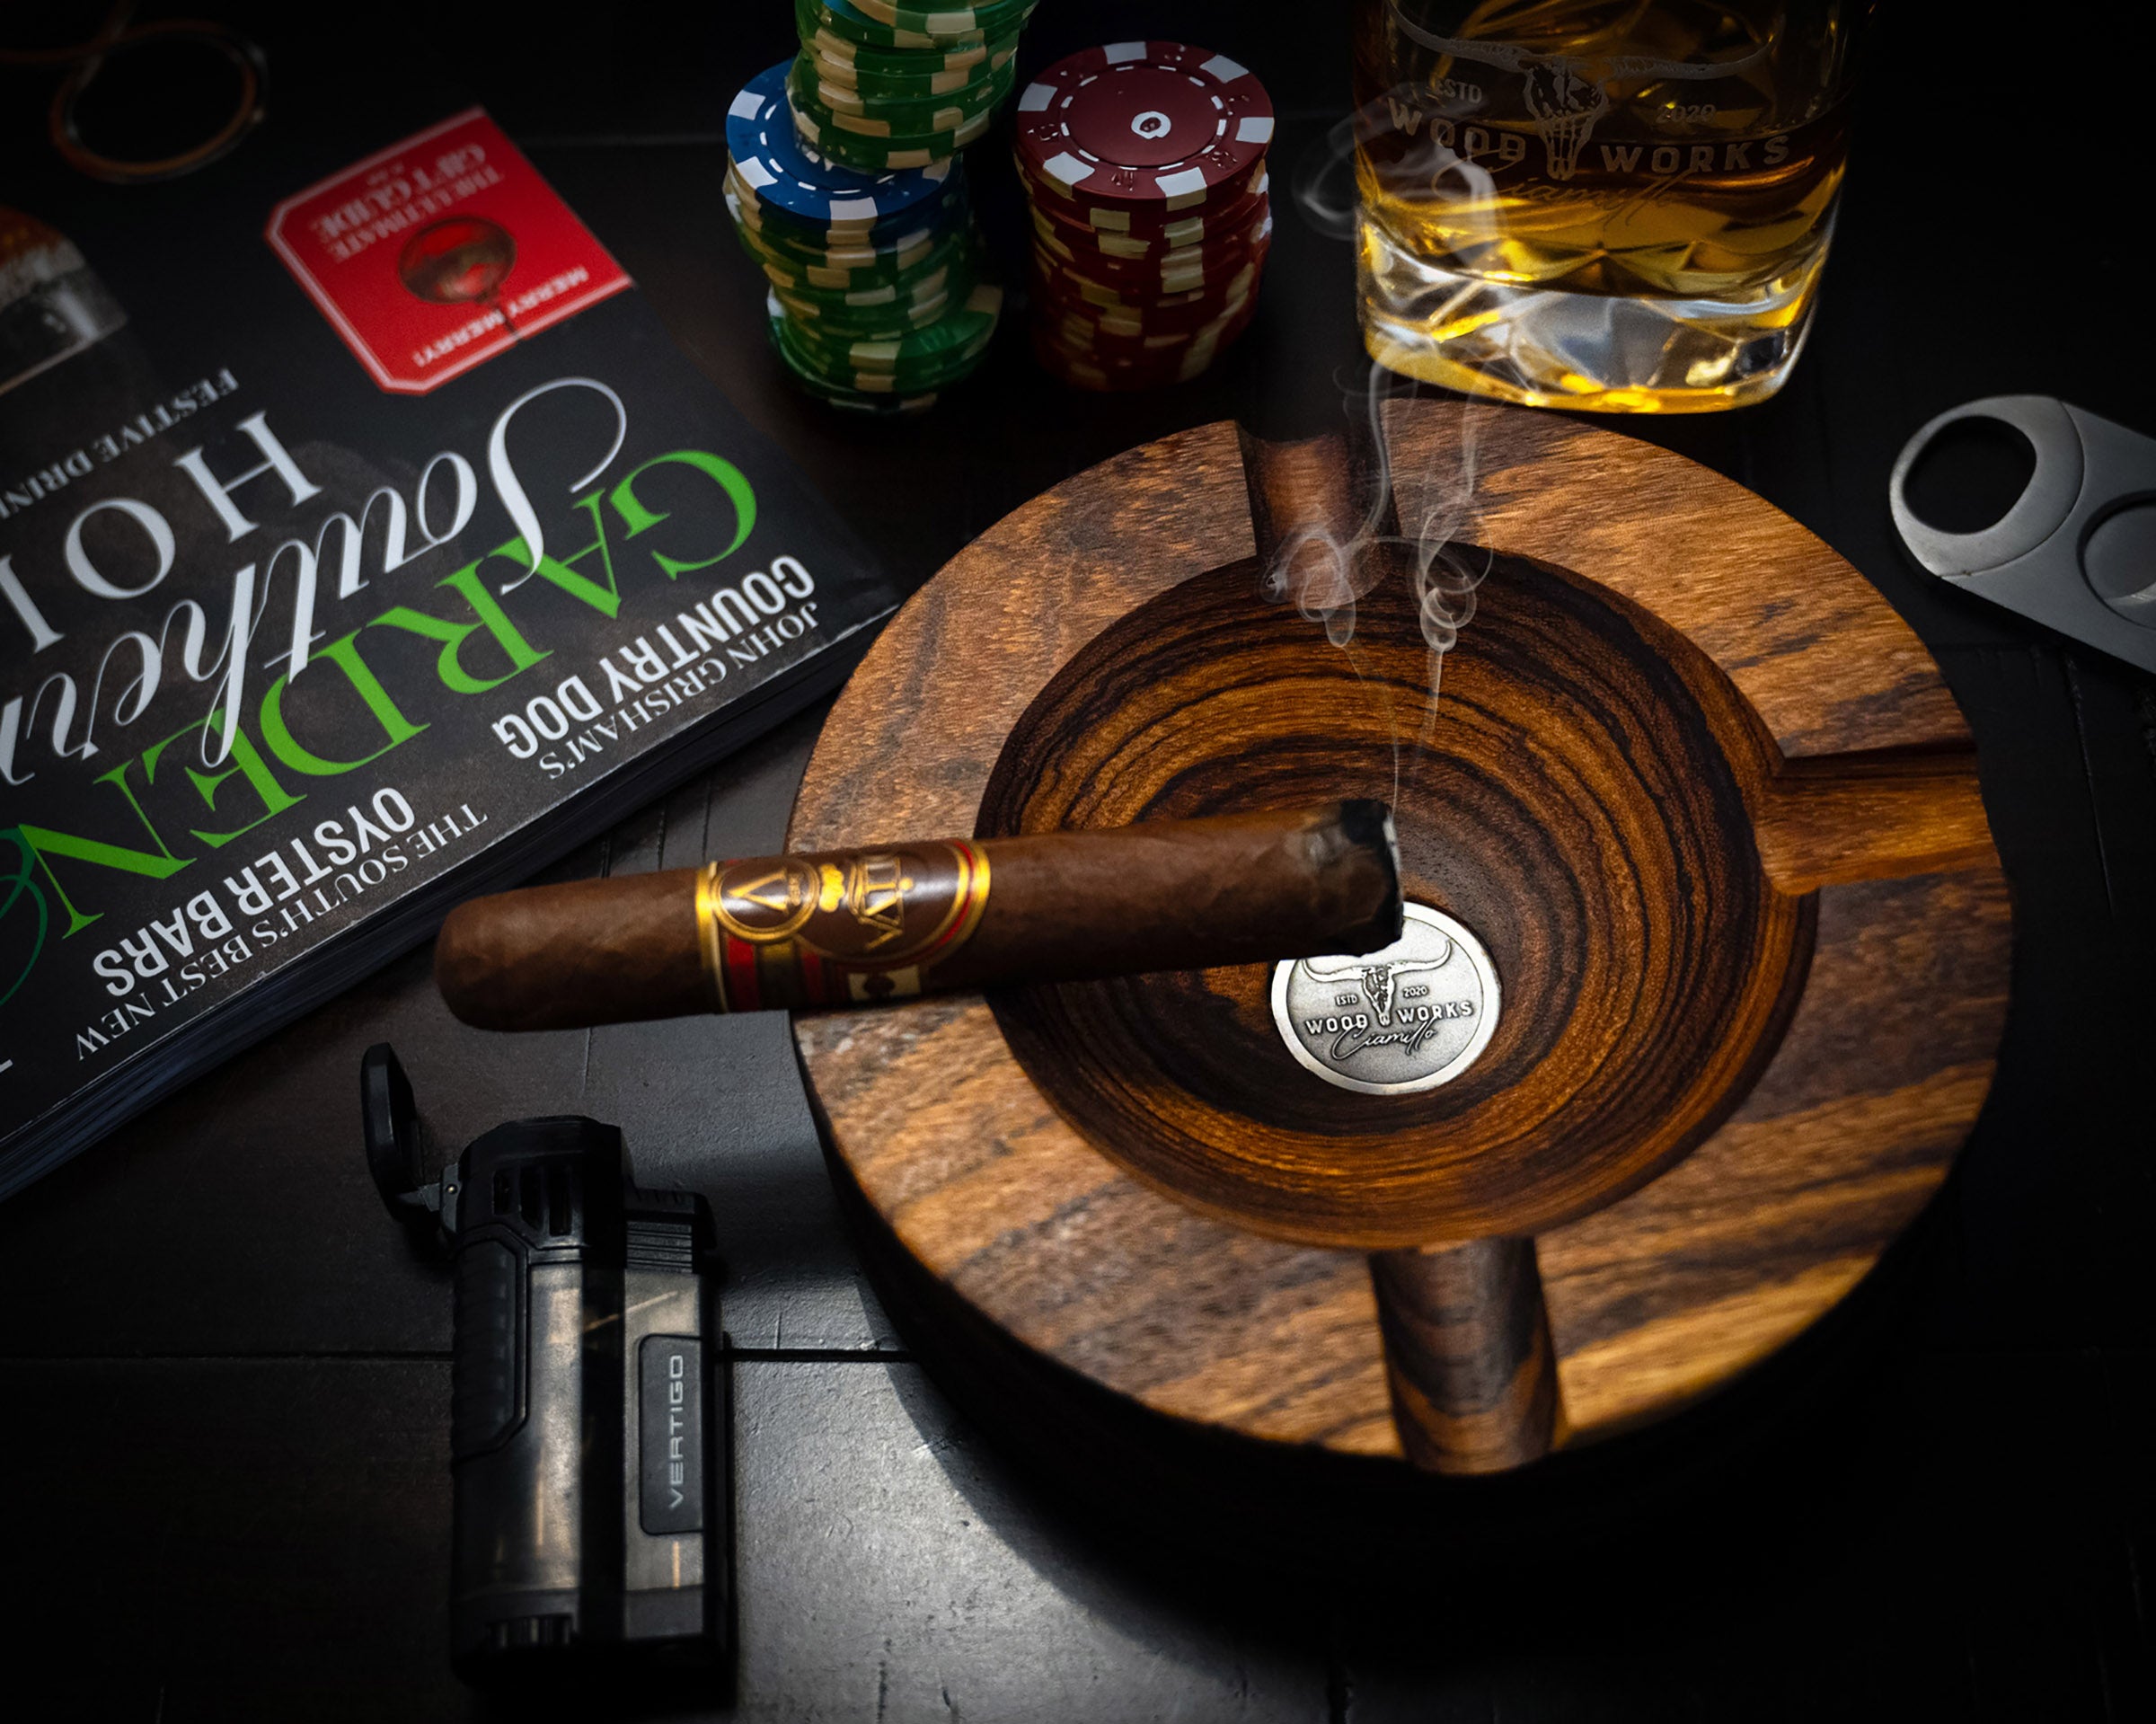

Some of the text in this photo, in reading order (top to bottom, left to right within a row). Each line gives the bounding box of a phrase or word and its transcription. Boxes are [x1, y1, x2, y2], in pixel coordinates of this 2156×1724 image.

[1388, 96, 1790, 174] WOOD WORKS
[507, 266, 589, 318] MERRY
[93, 367, 240, 463] FESTIVE
[20, 450, 757, 940] GARDEN
[491, 554, 816, 760] COUNTRY DOG
[539, 601, 819, 781] JOHN GRISHAM'S
[223, 787, 417, 916] OYSTER
[75, 802, 488, 1063] THE SOUTH'S BEST NEW
[93, 889, 234, 997] BARS
[1305, 1000, 1473, 1035] WOOD WORKS
[1402, 986, 1428, 998] 2020
[668, 1354, 685, 1511] VERTIGO
